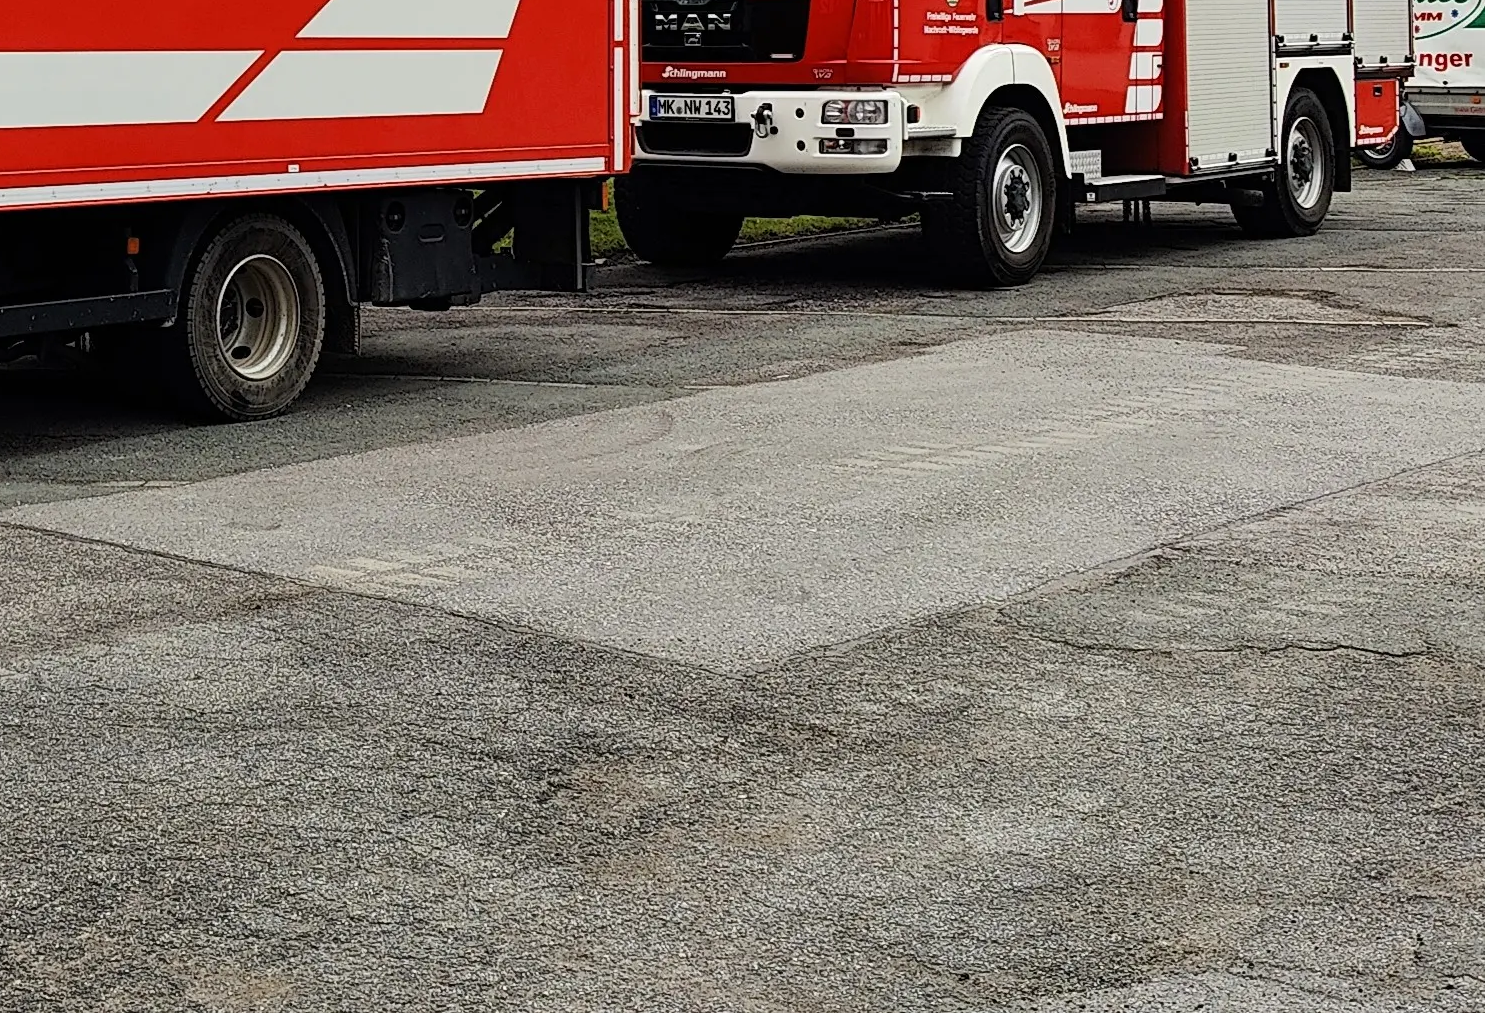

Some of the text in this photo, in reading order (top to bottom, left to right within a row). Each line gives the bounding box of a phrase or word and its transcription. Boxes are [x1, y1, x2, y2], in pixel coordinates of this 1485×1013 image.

[655, 13, 732, 31] MAN
[1415, 51, 1473, 72] nger
[662, 66, 727, 80] Schlingmann
[658, 100, 730, 116] MK NW 143
